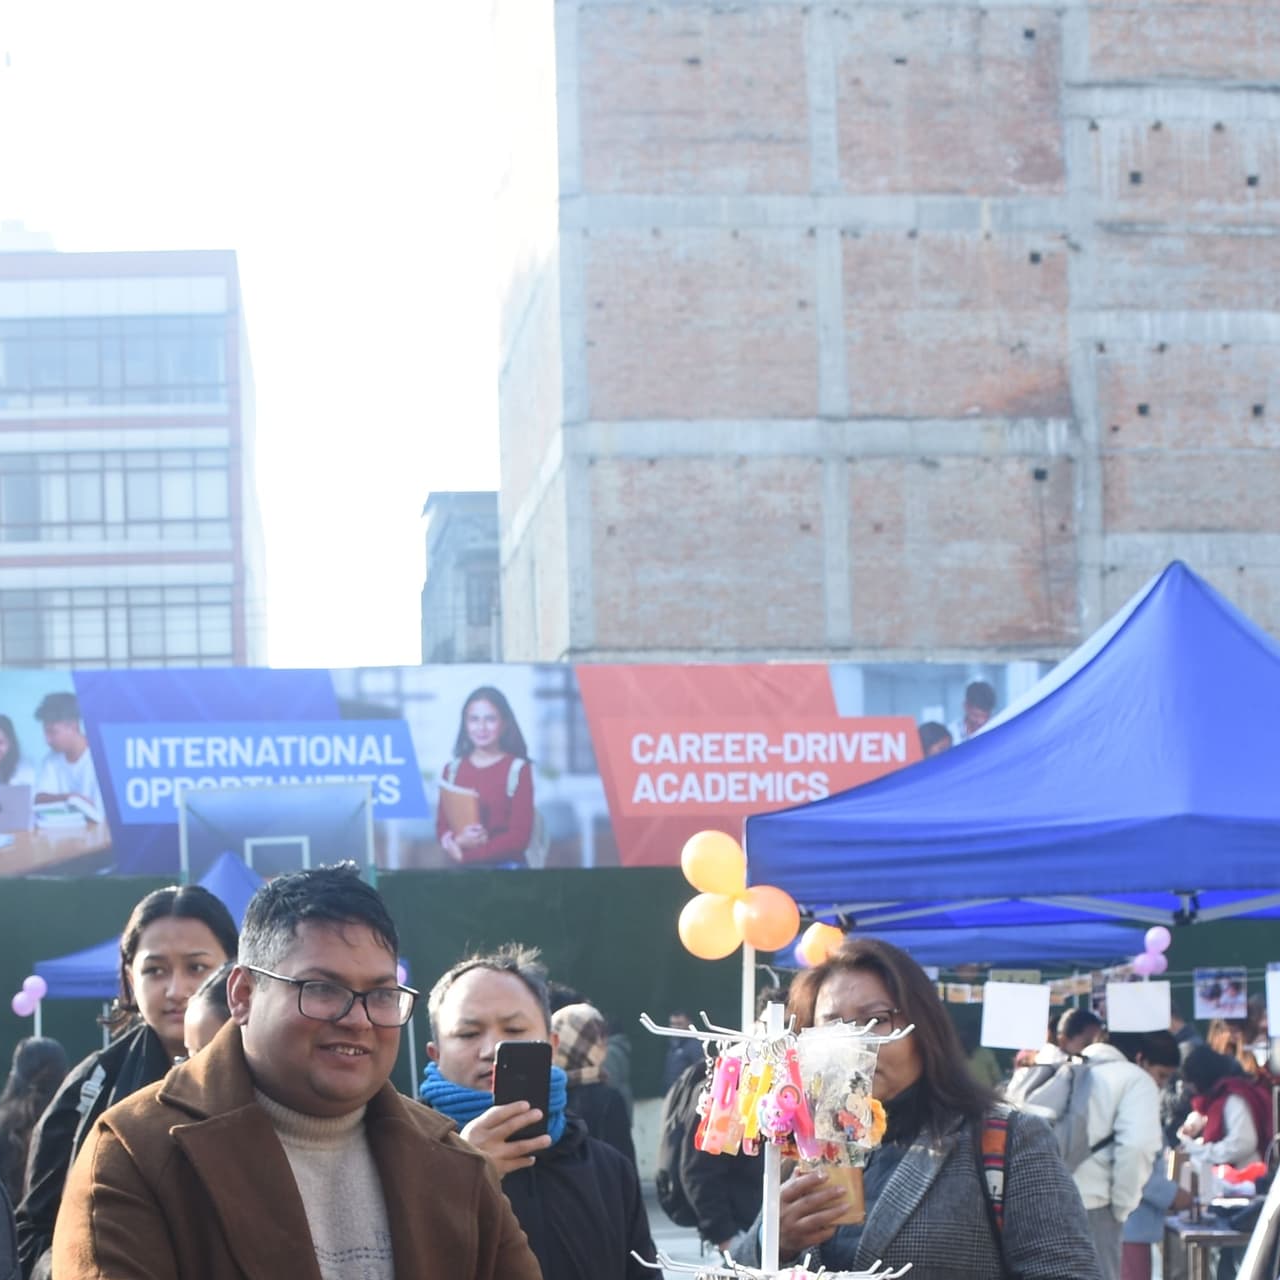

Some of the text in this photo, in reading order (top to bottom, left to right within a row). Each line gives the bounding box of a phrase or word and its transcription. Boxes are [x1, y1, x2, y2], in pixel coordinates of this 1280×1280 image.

[125, 735, 405, 768] INTERNATIONAL
[631, 733, 907, 764] CAREER-DRIVEN
[632, 772, 830, 803] ACADEMICS
